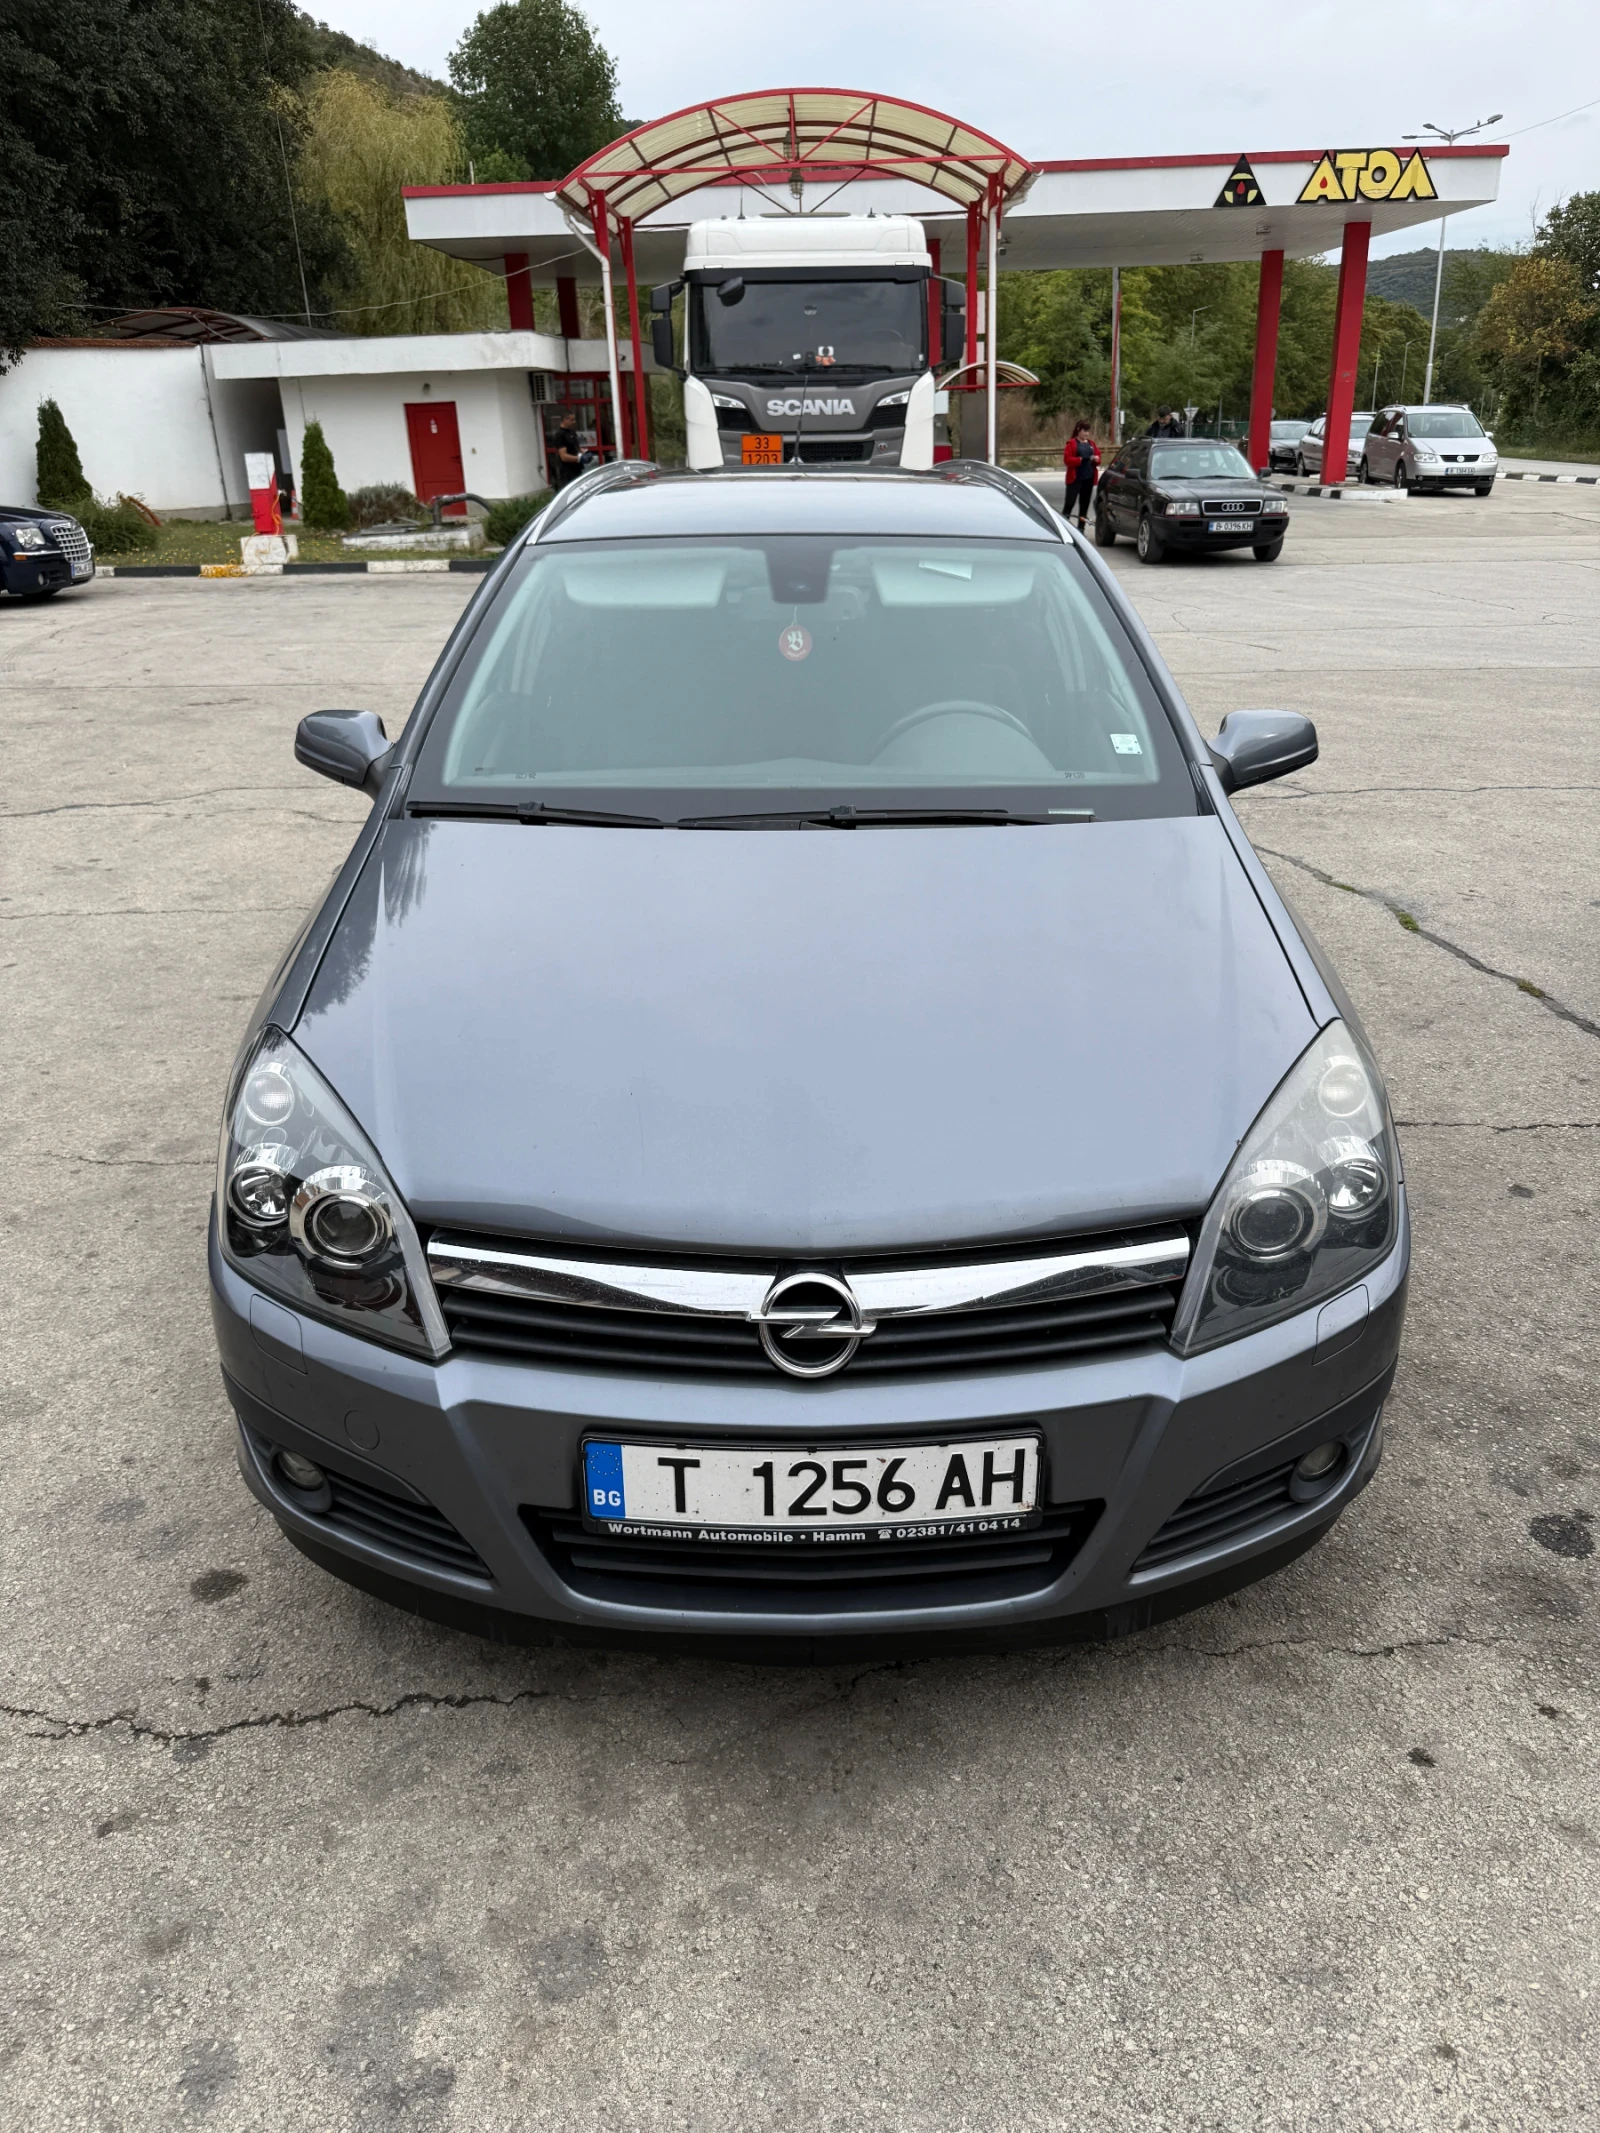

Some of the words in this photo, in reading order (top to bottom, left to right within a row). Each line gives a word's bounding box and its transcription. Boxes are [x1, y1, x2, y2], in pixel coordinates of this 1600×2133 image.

[766, 399, 856, 416] SCANIA
[755, 437, 769, 449] 33
[748, 454, 778, 464] 1203
[657, 1457, 700, 1513] T
[752, 1457, 916, 1516] 1256
[934, 1448, 1026, 1510] AH
[593, 1489, 621, 1507] BG
[608, 1523, 692, 1539] Wortmann
[698, 1530, 793, 1542] Automobile
[813, 1531, 866, 1542] Hamm
